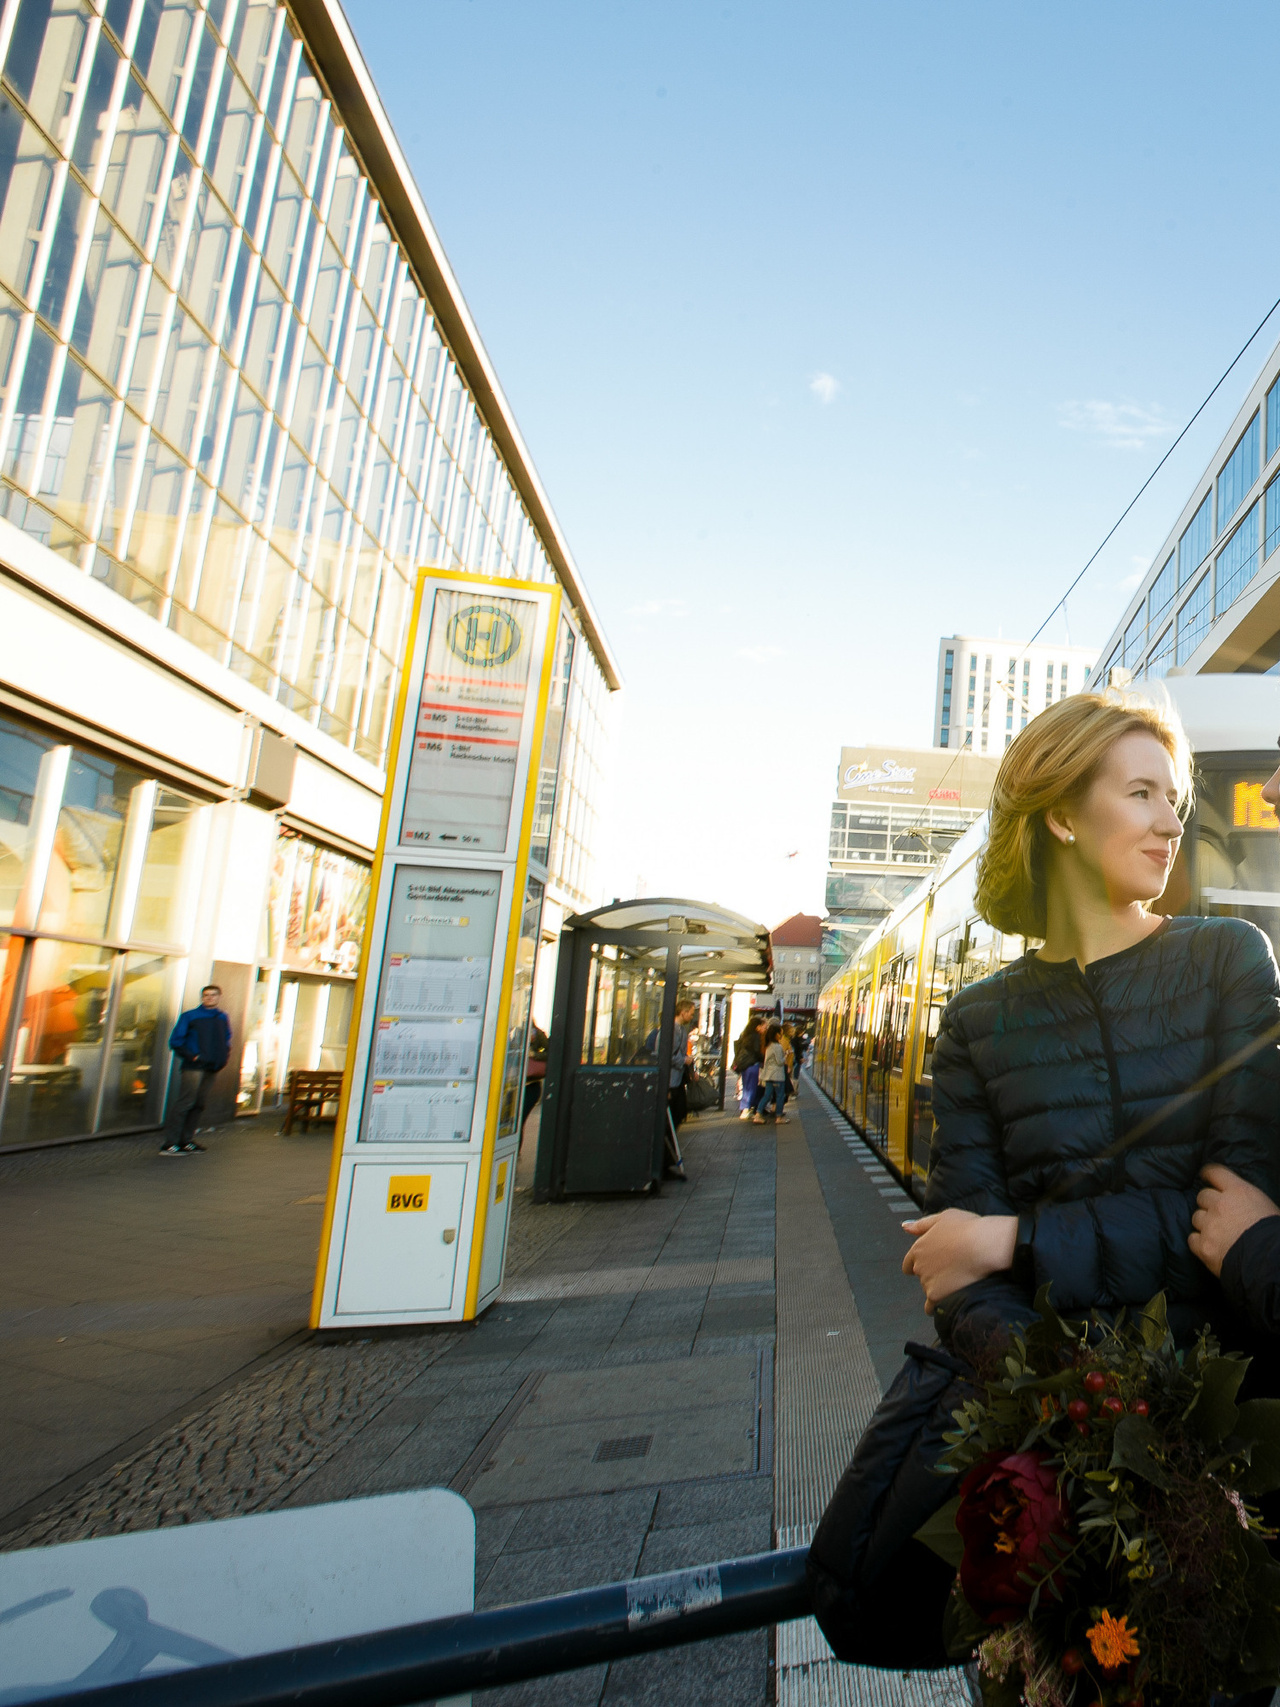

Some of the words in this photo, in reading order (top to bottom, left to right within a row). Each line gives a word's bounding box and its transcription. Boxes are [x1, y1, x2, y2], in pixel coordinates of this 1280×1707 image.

[431, 713, 447, 722] M5
[425, 742, 442, 751] M6
[413, 830, 431, 841] M2
[390, 1193, 424, 1209] BVG
